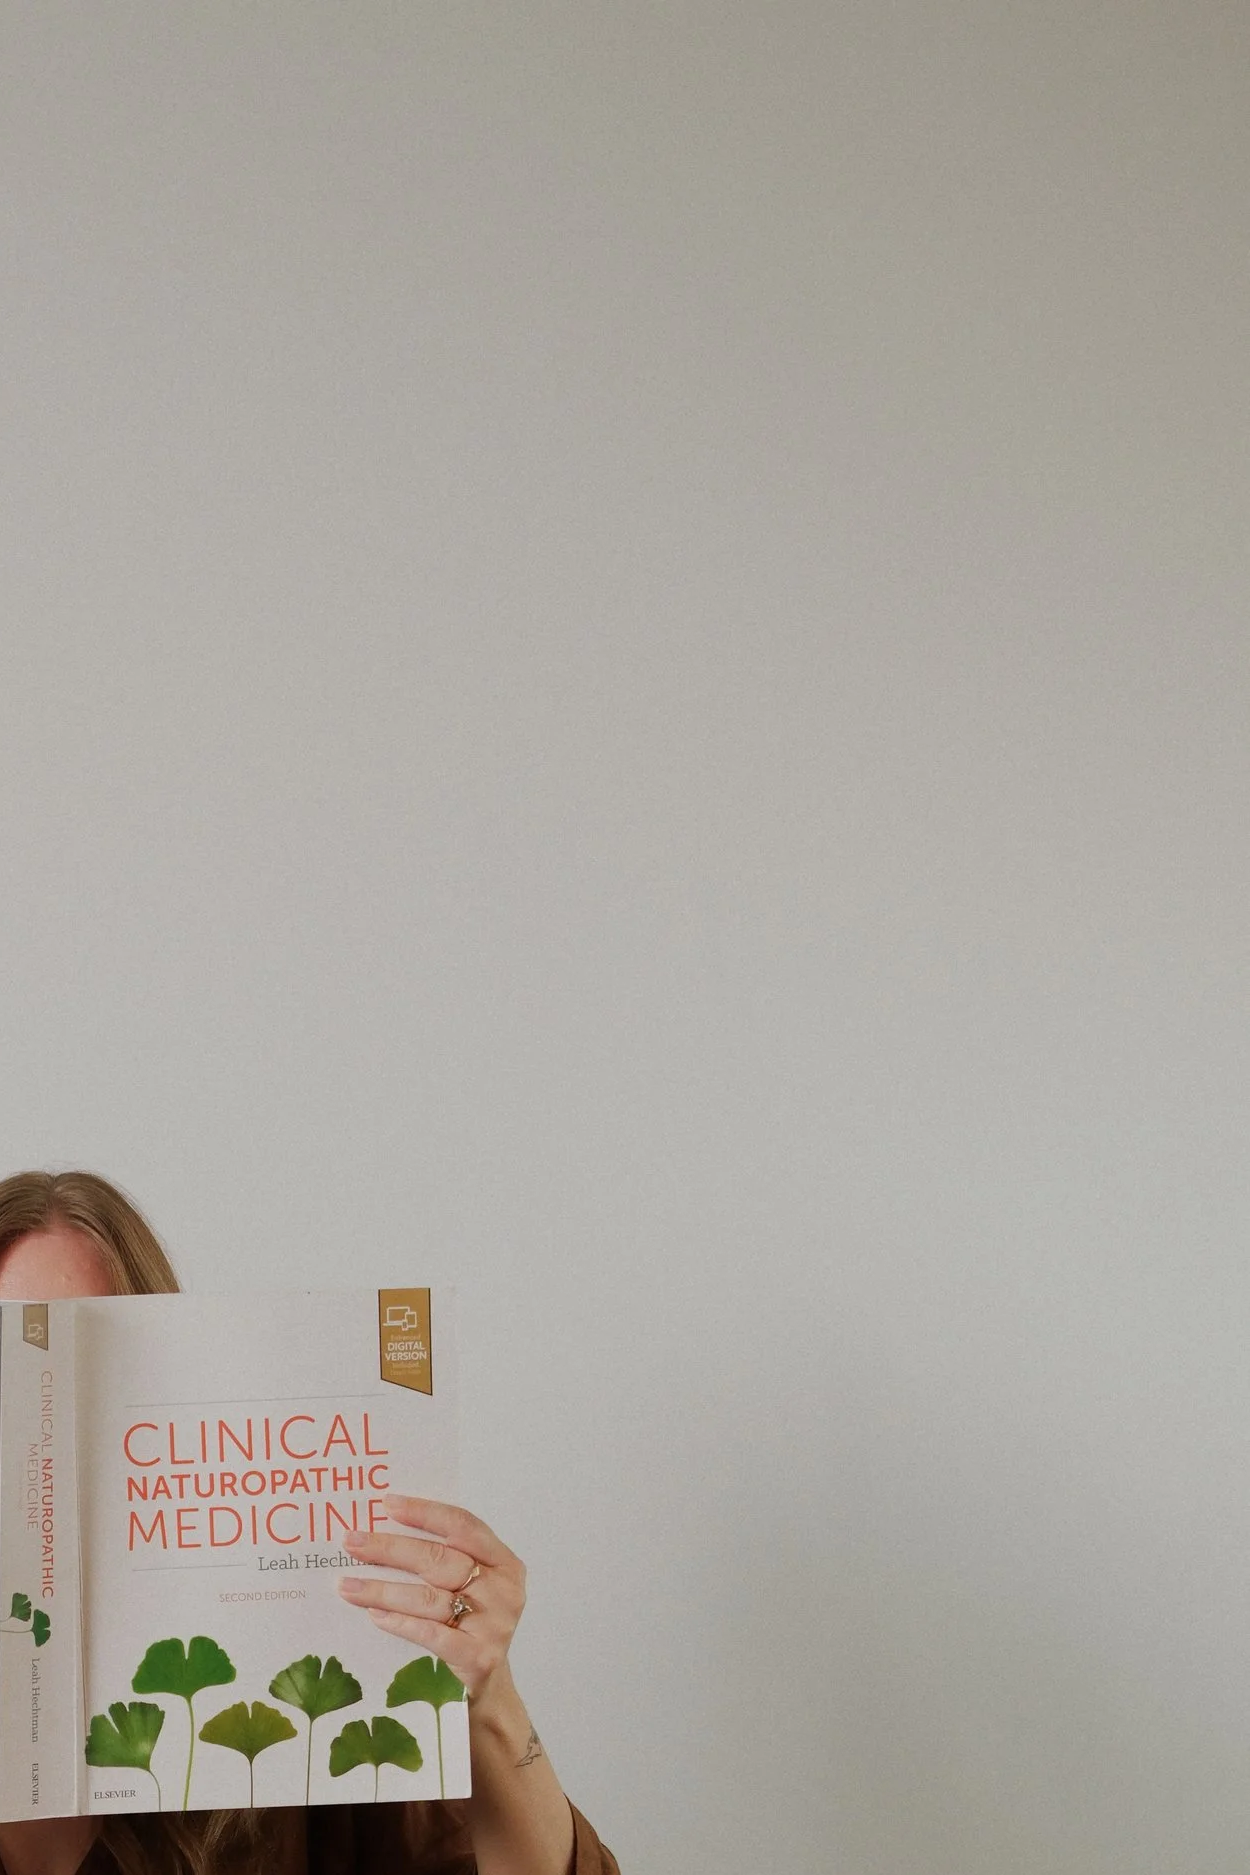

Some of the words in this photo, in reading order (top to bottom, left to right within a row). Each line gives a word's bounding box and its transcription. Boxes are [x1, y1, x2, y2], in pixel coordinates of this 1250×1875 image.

[385, 1351, 427, 1361] VERSION
[387, 1341, 426, 1351] DIGITAL
[40, 1370, 54, 1452] CLINICAL
[123, 1413, 389, 1468] CLINICAL
[27, 1443, 39, 1530] MEDICINE
[127, 1465, 390, 1501] NATUROPATHIC
[41, 1458, 54, 1598] NATUROPATHIC
[128, 1499, 389, 1551] MEDICINE
[258, 1553, 299, 1571] Leah
[219, 1592, 262, 1603] SECOND
[264, 1590, 306, 1600] EDITION
[31, 1658, 42, 1683] Leah
[31, 1687, 42, 1743] Hechtman
[31, 1763, 39, 1805] ELSEVIER
[94, 1789, 136, 1799] ELSEVIER
